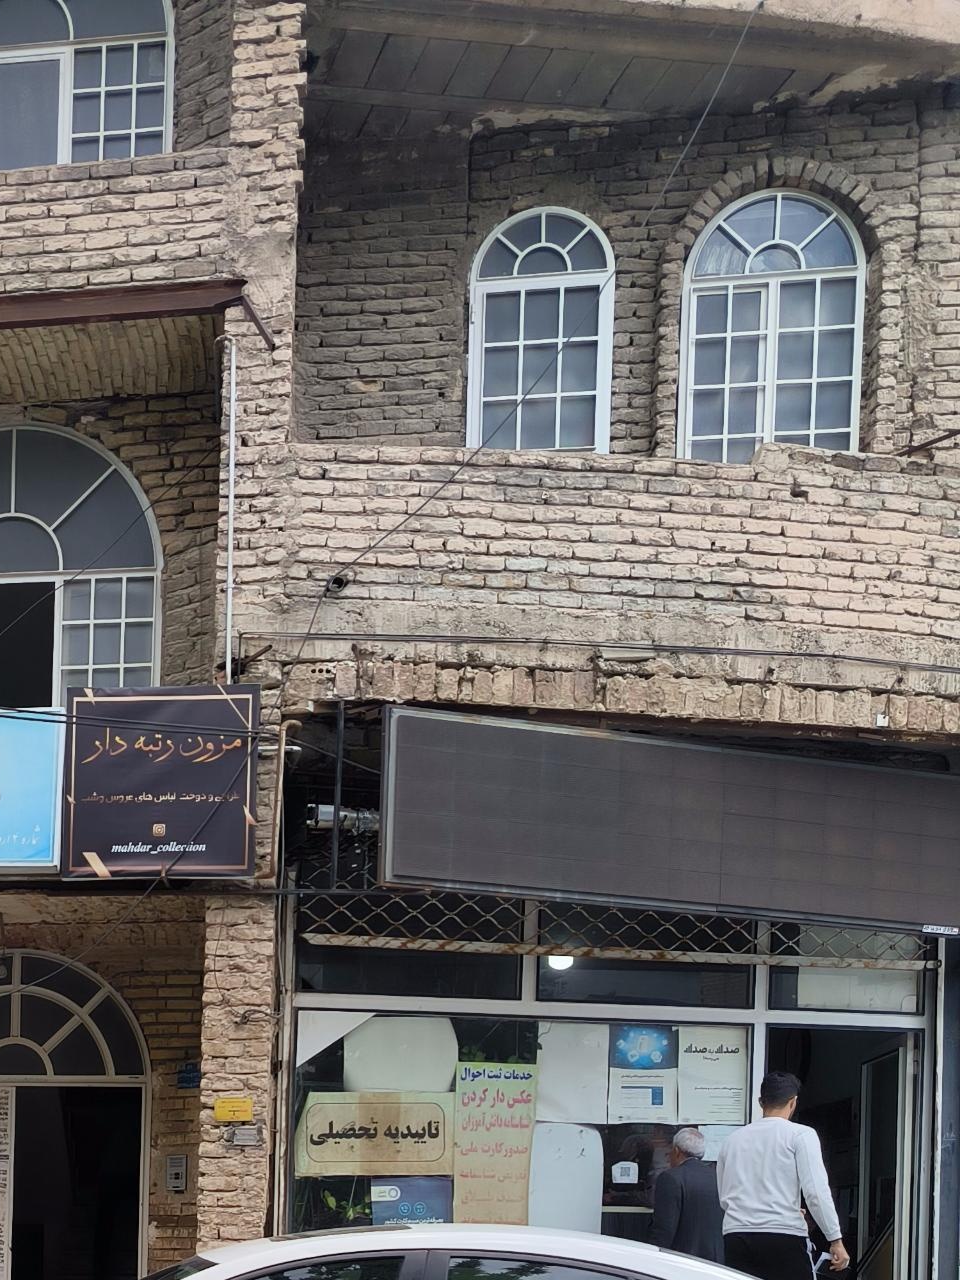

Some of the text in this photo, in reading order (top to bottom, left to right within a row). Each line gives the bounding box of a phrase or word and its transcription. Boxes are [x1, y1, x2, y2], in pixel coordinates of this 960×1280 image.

[81, 727, 243, 764] مزون رتبه دار
[106, 794, 134, 804] عروس
[135, 791, 153, 803] های
[154, 791, 176, 804] لباس
[179, 792, 207, 803] دوخت
[214, 791, 240, 802] طرای
[111, 841, 207, 854] mahdar_collecion
[460, 1067, 533, 1082] خدمات ثبت احوال
[461, 1088, 533, 1109] عکس دار کردن
[309, 1119, 440, 1146] تاییدیه تحصیلی
[460, 1142, 529, 1158] صدور کارت ملی
